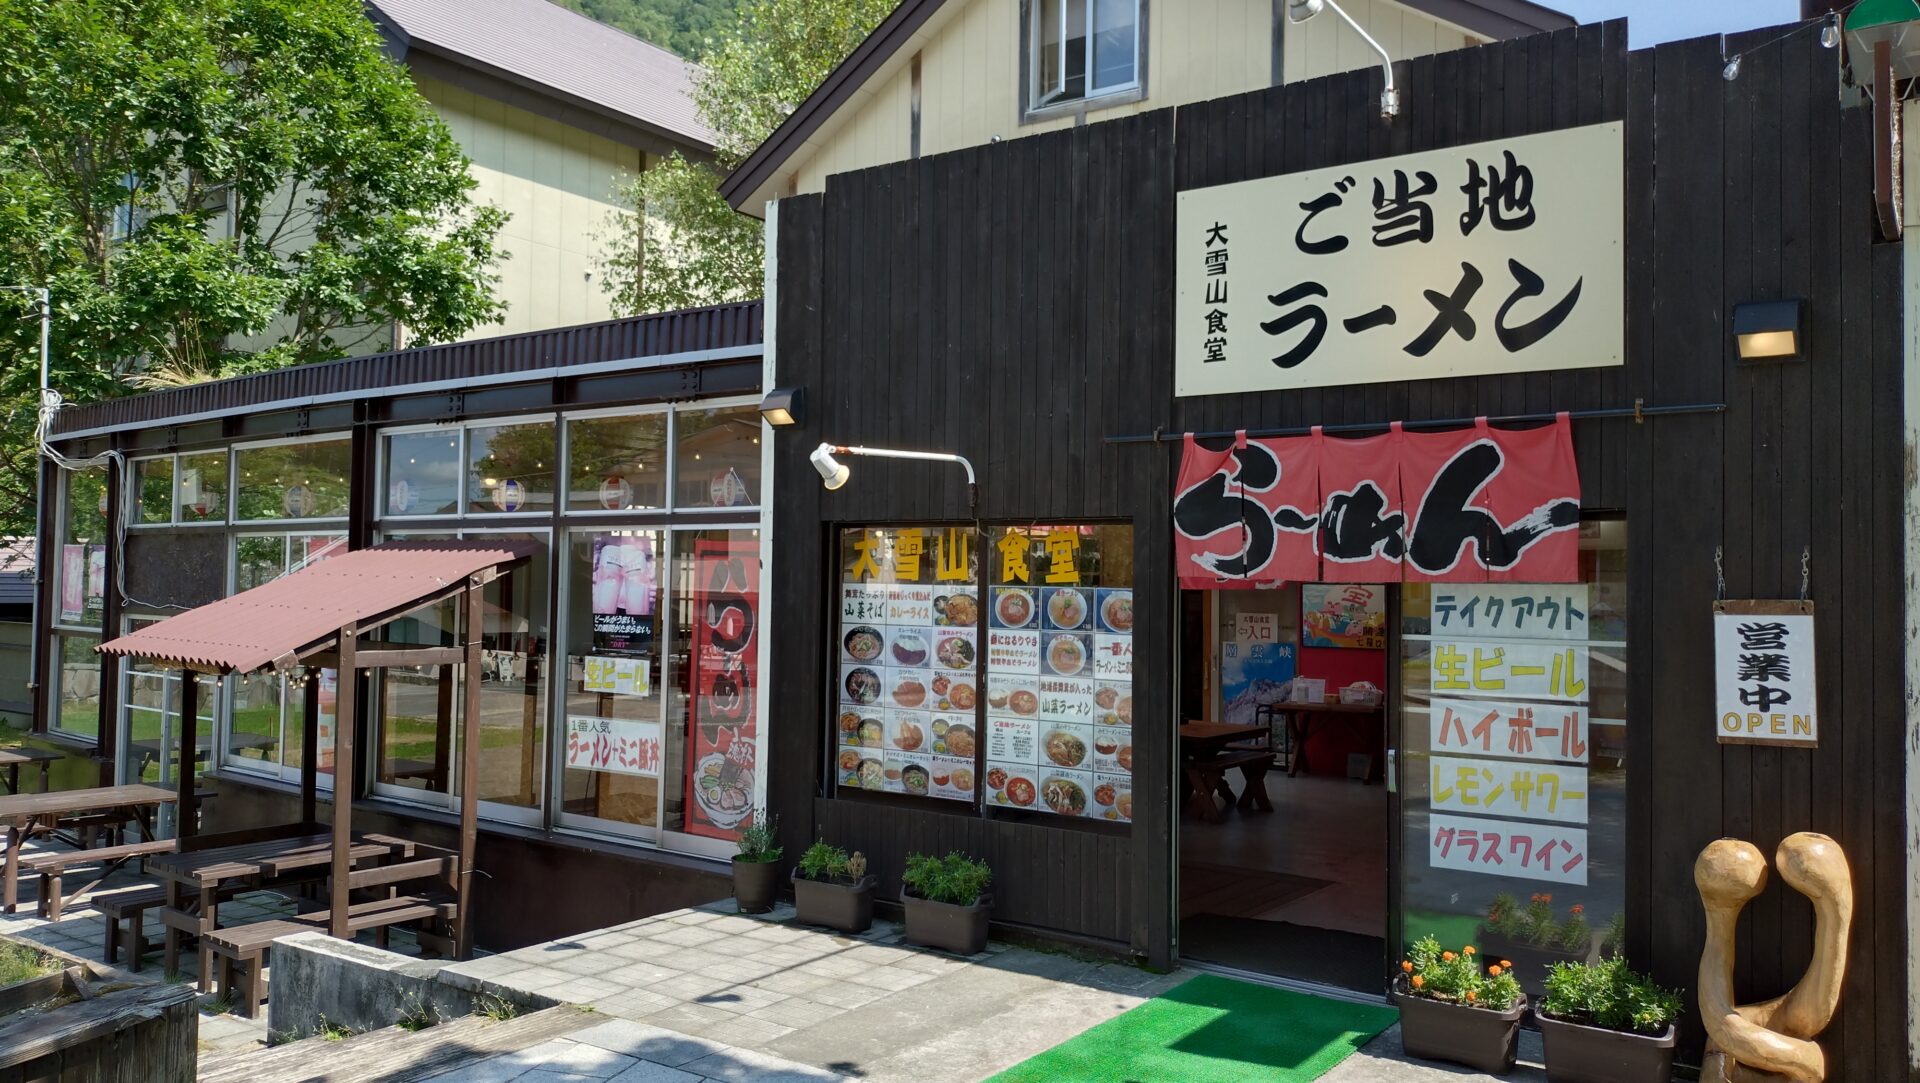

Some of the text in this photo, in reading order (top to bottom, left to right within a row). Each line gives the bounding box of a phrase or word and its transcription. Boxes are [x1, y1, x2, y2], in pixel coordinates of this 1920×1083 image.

[1295, 150, 1537, 255] ご当地
[1203, 221, 1230, 364] 大雪山食堂
[1260, 257, 1584, 369] ラーメン
[852, 527, 1080, 583] 大雪山食堂
[1247, 626, 1271, 640] 入口
[1434, 595, 1585, 630] テイクアウト
[585, 658, 649, 694] 生ビール
[1433, 644, 1586, 698] 生ビール
[1736, 622, 1792, 712] 営業中
[571, 719, 612, 735] 1番人気
[1438, 706, 1586, 757] ハイボール
[1722, 712, 1812, 735] OPEN
[1433, 764, 1586, 814] レモンサワー
[1434, 826, 1584, 874] グラスワイン
